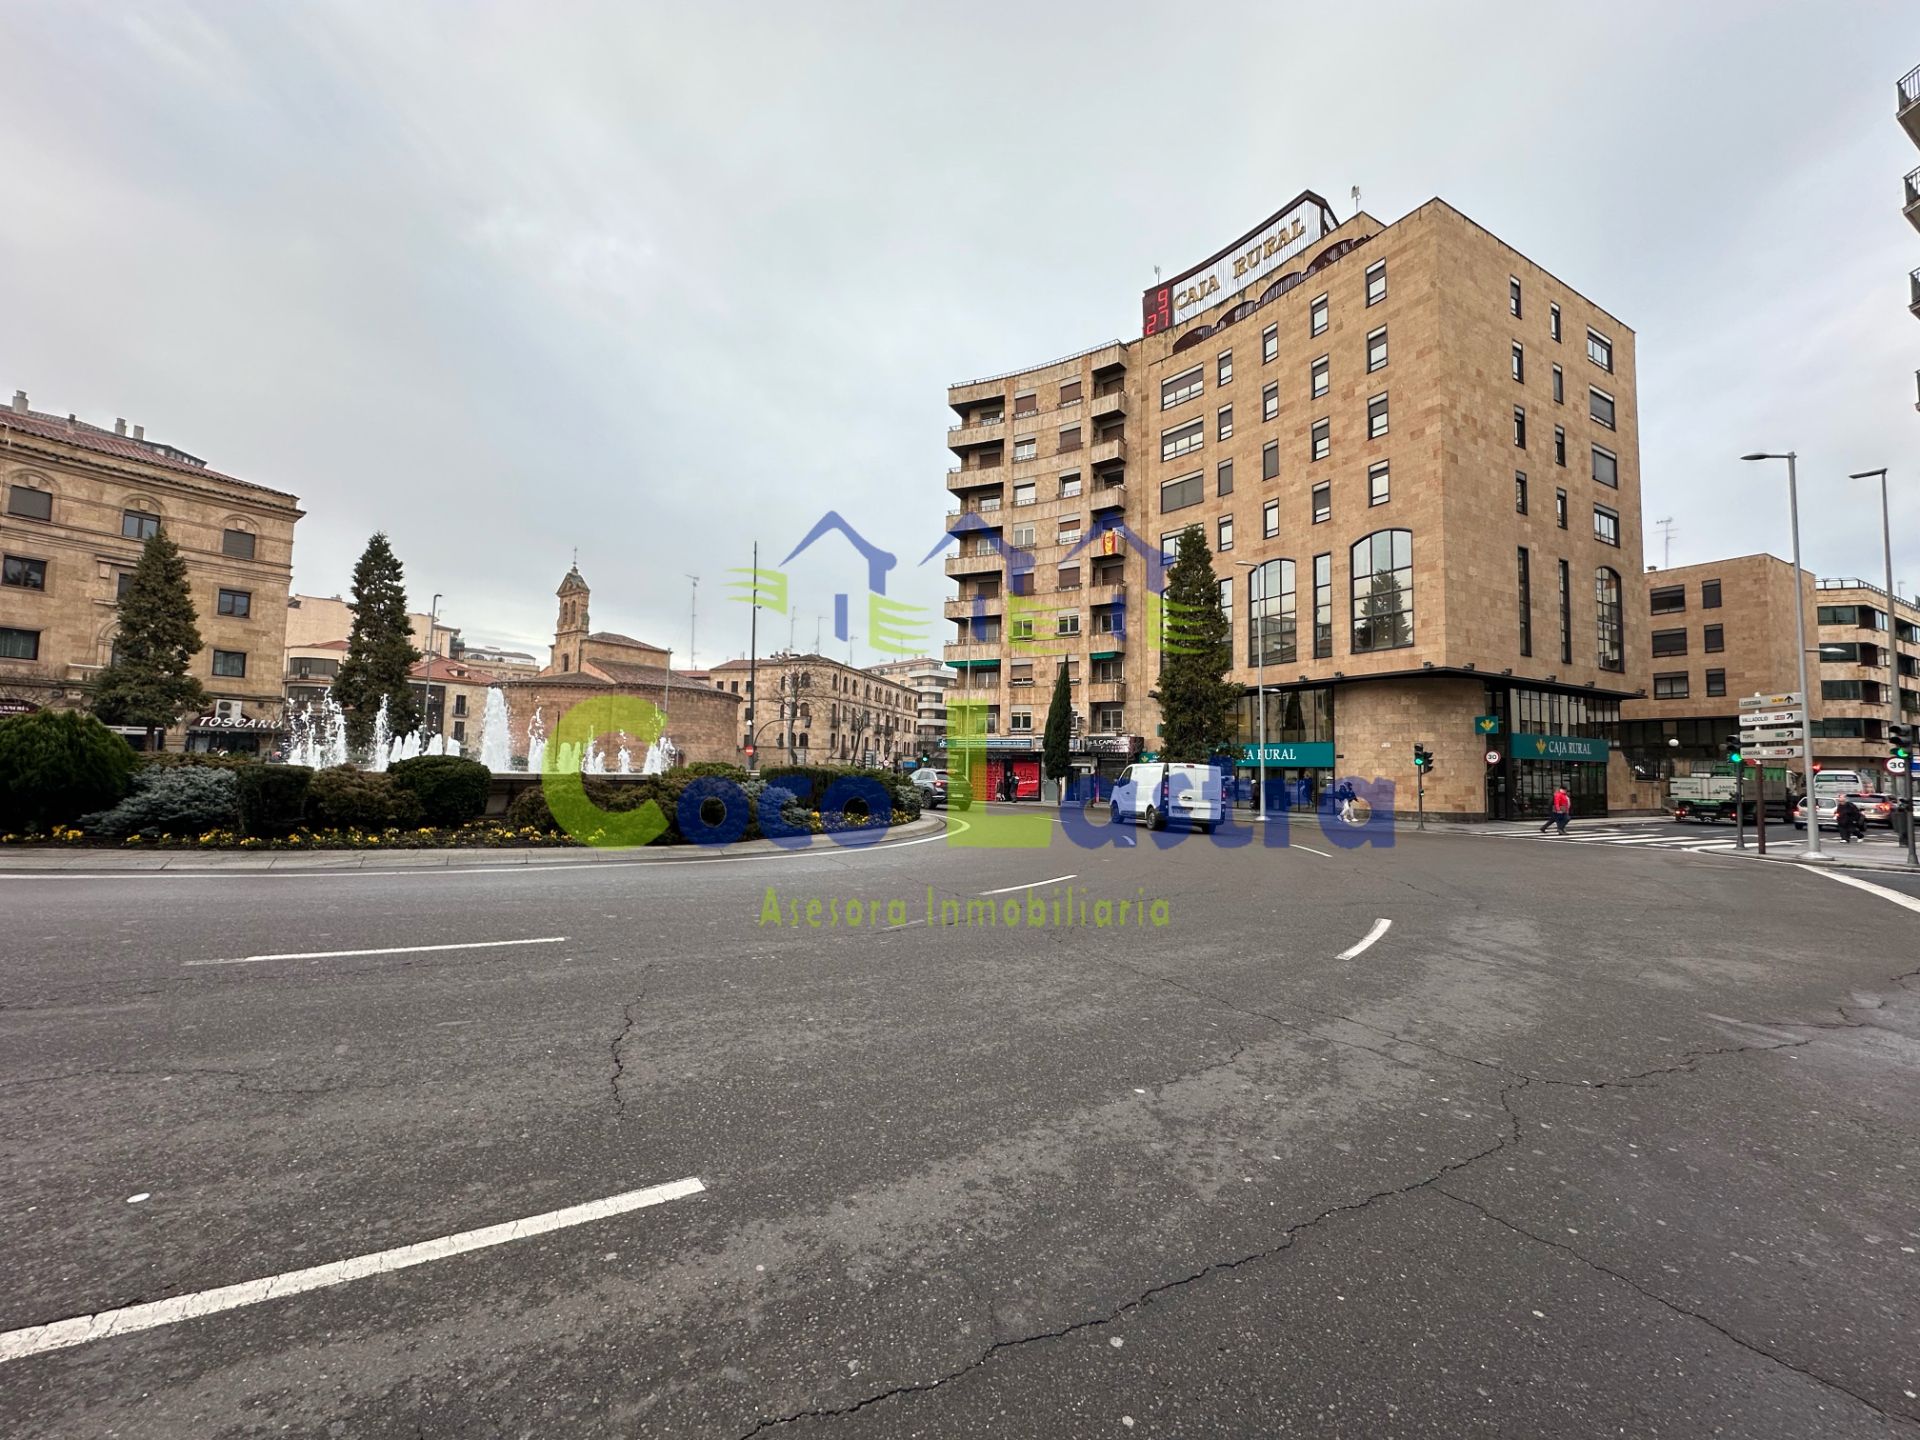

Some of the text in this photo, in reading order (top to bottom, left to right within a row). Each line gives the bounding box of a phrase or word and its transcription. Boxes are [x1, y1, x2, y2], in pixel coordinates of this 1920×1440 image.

[1173, 217, 1306, 311] CAJA RURAL
[1157, 288, 1168, 311] 9
[1146, 309, 1169, 335] 27
[1742, 715, 1769, 723] VALLADOLID
[1548, 741, 1592, 757] CAJA RURAL
[1889, 761, 1905, 769] 30
